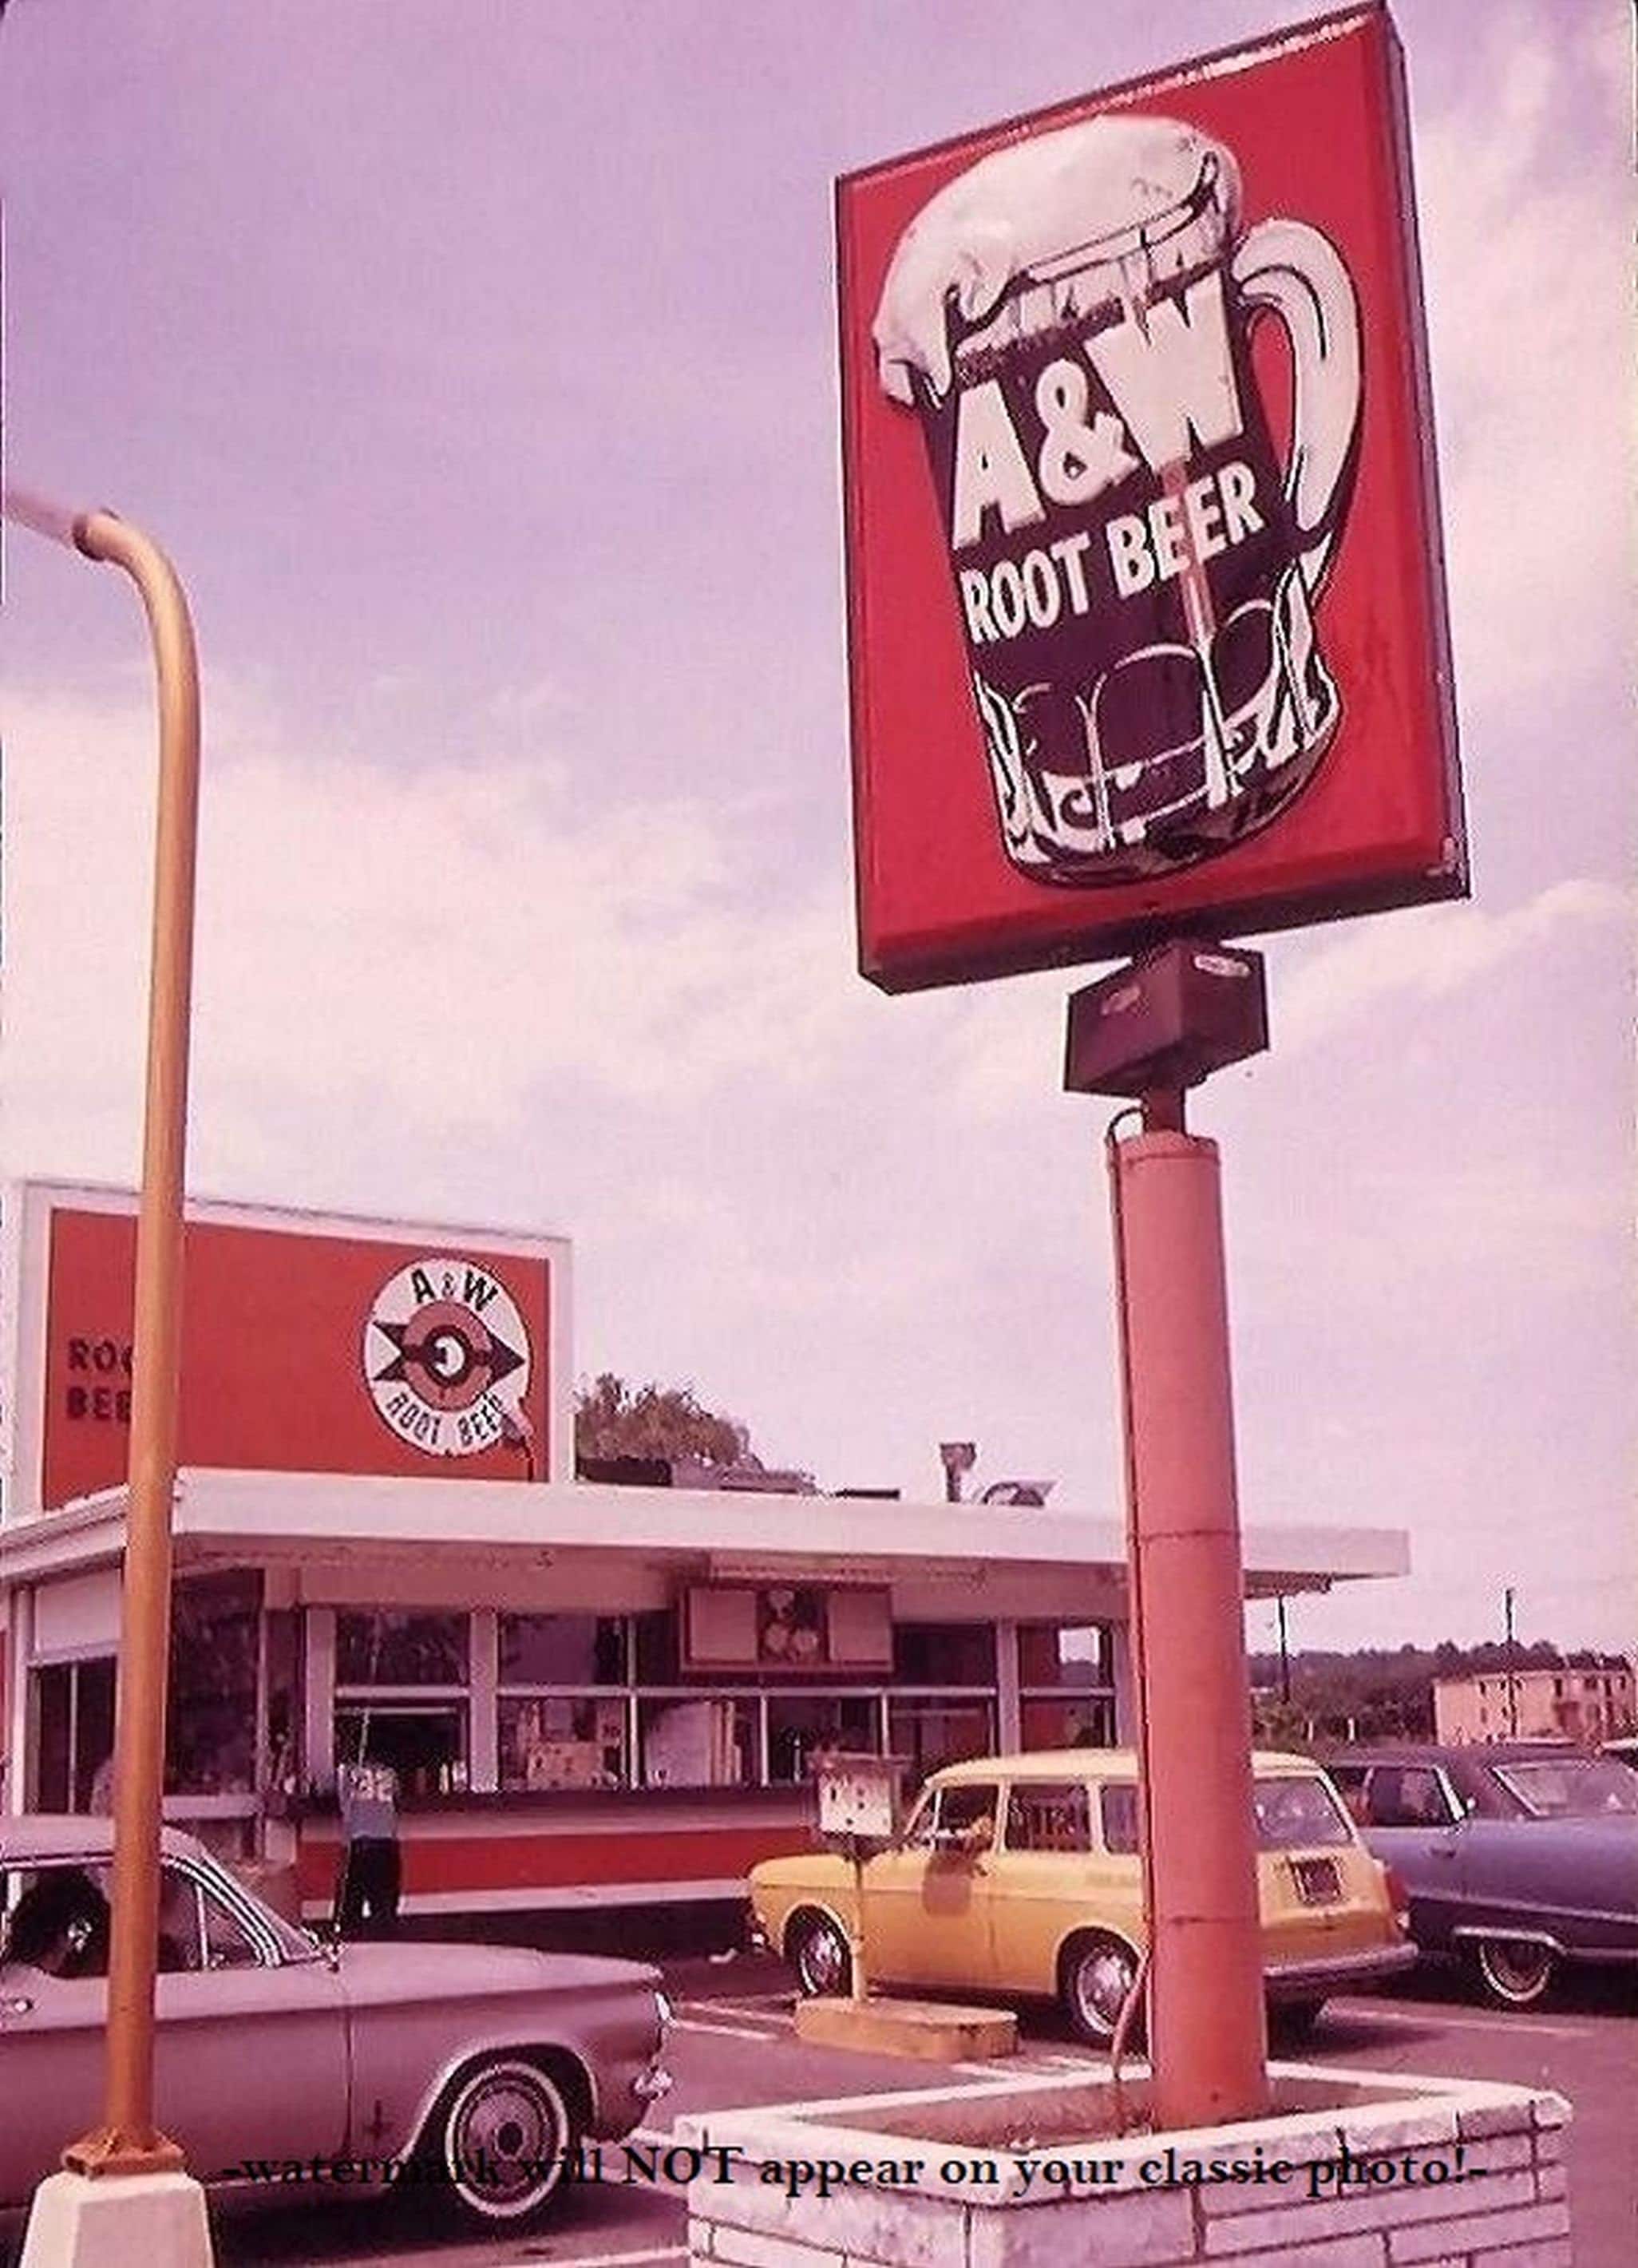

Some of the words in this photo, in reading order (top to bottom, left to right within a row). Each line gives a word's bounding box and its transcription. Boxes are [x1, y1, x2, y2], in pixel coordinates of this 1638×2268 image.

[952, 271, 1244, 551] A&W
[960, 532, 1092, 645] ROOT
[1106, 461, 1264, 599] BEER
[386, 1392, 441, 1445] ROOT
